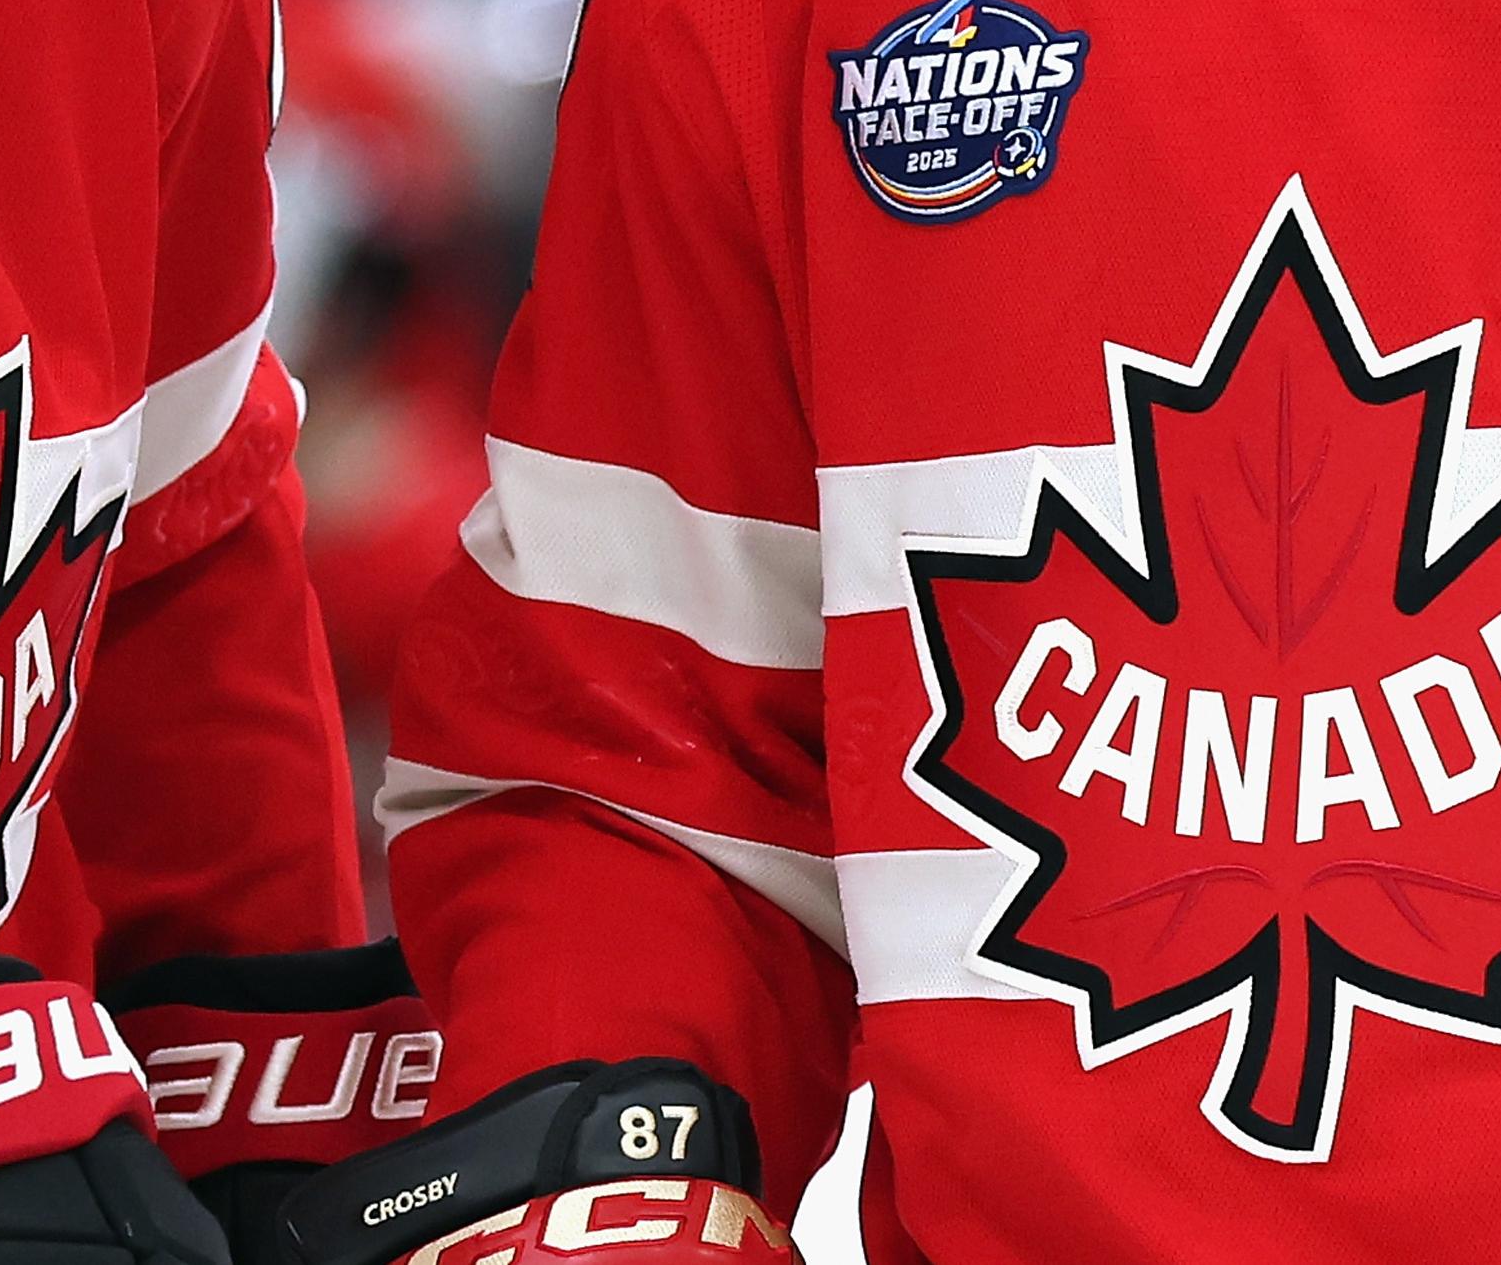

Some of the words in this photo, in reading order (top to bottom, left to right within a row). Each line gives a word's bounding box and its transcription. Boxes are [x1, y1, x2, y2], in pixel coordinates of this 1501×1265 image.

[839, 41, 1080, 111] NATIONS
[857, 92, 1046, 147] FACE-OFF
[906, 148, 958, 173] 2025
[619, 1104, 700, 1161] 87
[363, 1171, 460, 1227] CROSBY
